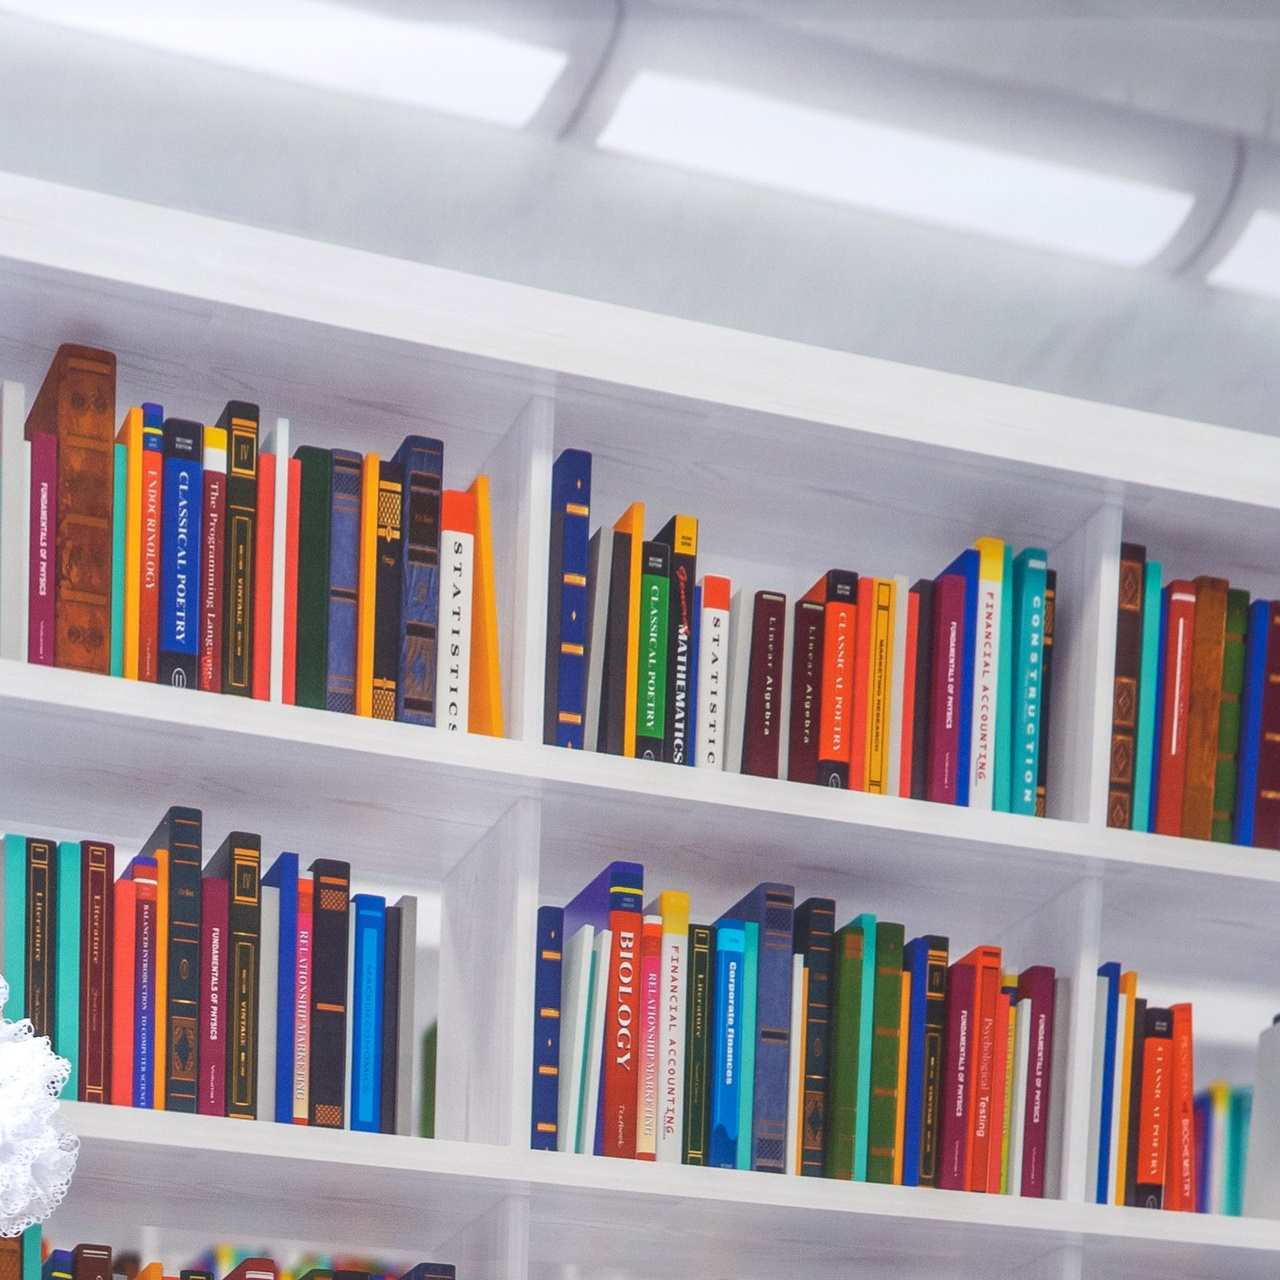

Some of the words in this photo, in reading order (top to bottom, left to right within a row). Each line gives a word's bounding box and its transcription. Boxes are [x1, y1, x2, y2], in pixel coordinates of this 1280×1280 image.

[175, 436, 193, 445] SECOND
[175, 443, 192, 451] EDITION
[39, 482, 48, 547] FUNDAMENTALS
[176, 471, 189, 573] CLASSICAL
[208, 482, 219, 510] The
[39, 549, 47, 559] OF
[145, 471, 158, 590] ENDOCRINOLOGY
[206, 513, 218, 608] Programming
[38, 561, 47, 596] PHYSICS
[175, 574, 187, 644] POETRY
[676, 565, 691, 635] General
[647, 585, 659, 668] CLASSICAL
[767, 617, 776, 669] Linear
[806, 626, 816, 676] Linear
[835, 612, 847, 693] CLASSICAL
[947, 621, 957, 682] FUNDAMENTALS
[982, 592, 994, 677] FINANCIAL
[673, 624, 688, 764] MATHEMATICS
[876, 639, 885, 696] MARKETING
[947, 684, 955, 694] OF
[645, 671, 656, 730] POETRY
[763, 675, 773, 735] Algebra
[803, 684, 813, 743] Algebra
[832, 697, 844, 752] POETRY
[873, 699, 882, 752] RESEARCH
[945, 696, 954, 729] PHYSICS
[1024, 596, 1041, 802] CONSTRUCTION
[977, 685, 990, 780] ACCOUNTING
[35, 892, 43, 962] Literature
[92, 895, 100, 964] Literature
[210, 927, 220, 993] FUNDAMENTALS
[297, 931, 309, 1021] RELATIONSHIP
[668, 946, 679, 1031] FINANCIAL
[141, 1016, 147, 1026] TO
[209, 1006, 218, 1040] PHYSICS
[210, 994, 218, 1004] OF
[615, 931, 634, 1072] BIOLOGY
[646, 973, 657, 1060] RELATIONSHIP
[695, 974, 705, 1038] Literature
[725, 962, 737, 1025] Corporate
[362, 964, 374, 1093] MACROECONOMICS
[957, 1011, 968, 1070] FUNDAMENTALS
[981, 1018, 994, 1090] Psychological
[1035, 1014, 1046, 1076] FUNDAMENTALS
[295, 1024, 306, 1100] MARKETING
[665, 1039, 677, 1134] ACCOUNTING
[958, 1073, 966, 1083] OF
[1035, 1077, 1043, 1088] OF
[617, 1105, 626, 1147] Textbook
[643, 1063, 655, 1136] MARKETING
[956, 1085, 965, 1117] PHYSICS
[976, 1096, 989, 1137] Testing
[1032, 1090, 1043, 1123] PHYSICS
